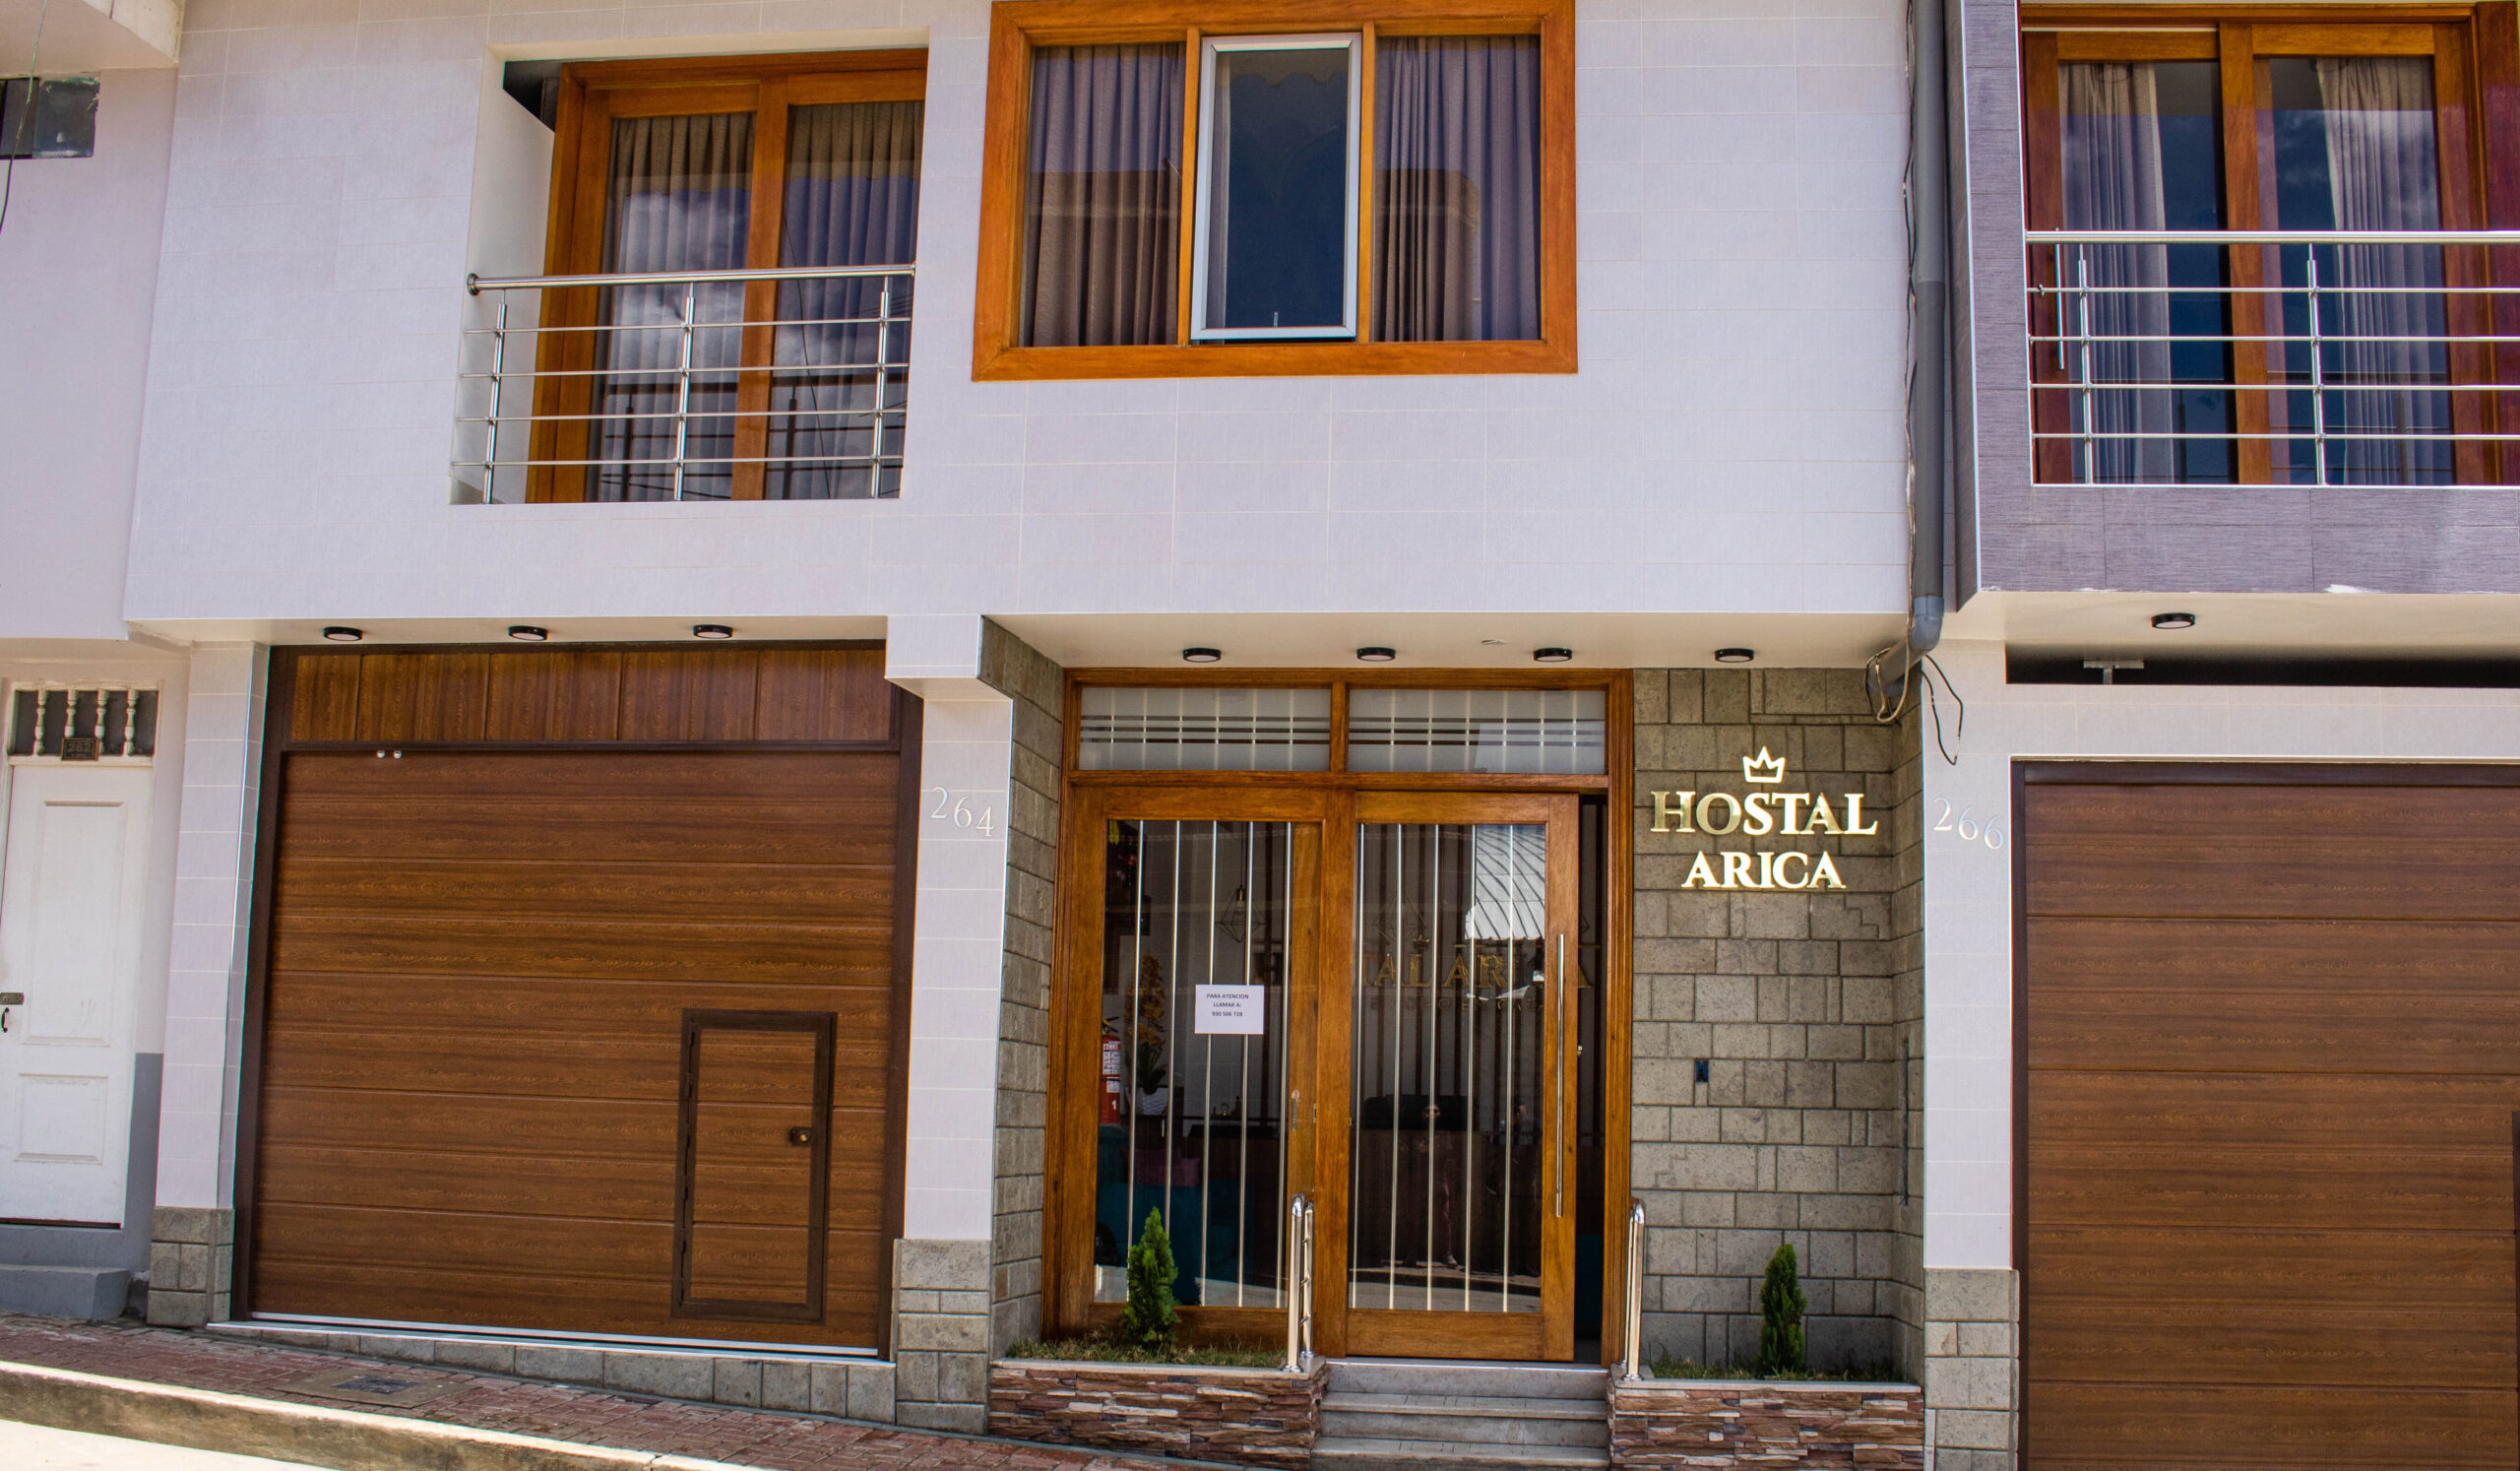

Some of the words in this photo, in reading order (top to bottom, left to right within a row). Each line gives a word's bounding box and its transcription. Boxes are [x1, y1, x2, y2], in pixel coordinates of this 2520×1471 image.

[929, 786, 995, 837] 264
[1650, 790, 1879, 836] HOSTAL
[1932, 797, 2004, 850] 266
[1680, 850, 1847, 889] ARICA
[1111, 1099, 1117, 1111] 1
